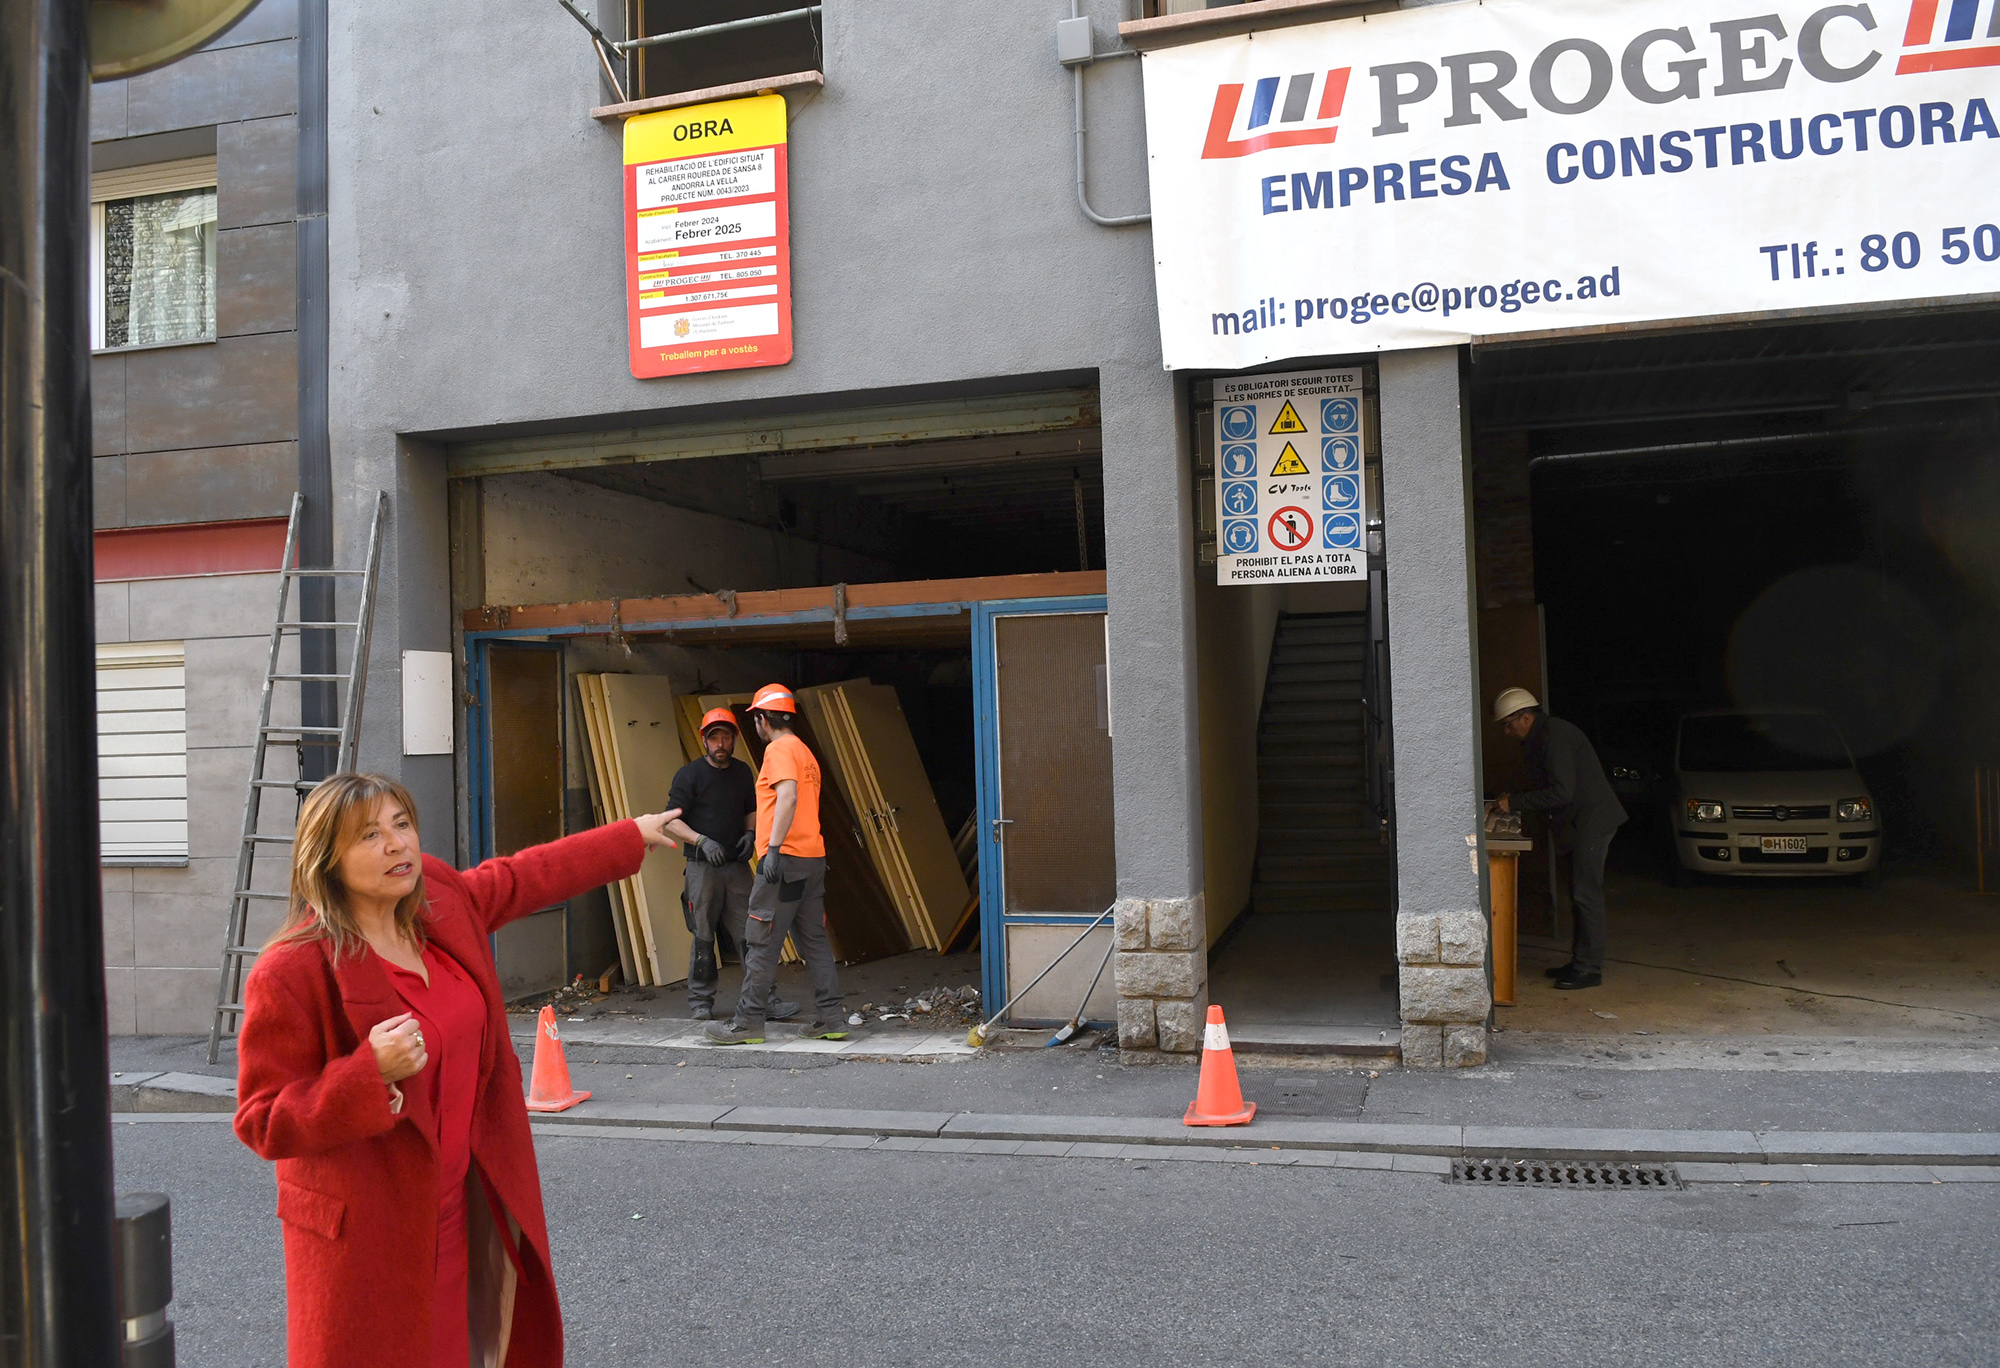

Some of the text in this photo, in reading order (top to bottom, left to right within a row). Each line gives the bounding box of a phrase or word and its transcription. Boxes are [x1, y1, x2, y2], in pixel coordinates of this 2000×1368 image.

[1368, 3, 1883, 137] PROGEC
[673, 118, 734, 142] OBRA
[1261, 97, 2000, 215] EMPRESA CONSTRUCTORA
[645, 153, 765, 176] REHABILITACIÓ DE L'EDIFICI SITUAT
[658, 174, 686, 184] CARRER
[687, 169, 721, 180] ROUREDA
[722, 167, 732, 175] DE
[733, 164, 756, 174] SANSA
[757, 163, 763, 171] 8
[671, 177, 738, 191] ANDORRA LA VELLA
[661, 185, 750, 202] PROJECTE NÚM. 0043/2023
[675, 219, 699, 228] Febrer
[701, 216, 720, 225] 2024
[675, 227, 712, 240] Febrer
[714, 223, 742, 235] 2025
[736, 251, 748, 259] 370
[1759, 223, 2000, 281] Tlf.: 80 50
[665, 275, 700, 287] PROGEC
[720, 272, 735, 280] TEL.
[749, 269, 762, 277] 050
[685, 291, 729, 302] 1.307.671,75€
[1211, 266, 1621, 336] mail: progec@progec.ad
[660, 350, 702, 362] Treballem
[704, 348, 719, 358] per
[728, 344, 759, 354] vostès
[1225, 374, 1354, 393] ÉS OBLIGATORI SEGUIR TOTES
[1228, 394, 1245, 402] LES
[1246, 390, 1282, 401] NORMES
[1284, 388, 1296, 397] DE
[1268, 484, 1288, 494] CV
[1236, 553, 1351, 567] PROHIBIT EL PAS A TOTA
[1231, 565, 1357, 579] PERSONA ALIENA A L'OBRA
[1773, 838, 1805, 849] H1602
